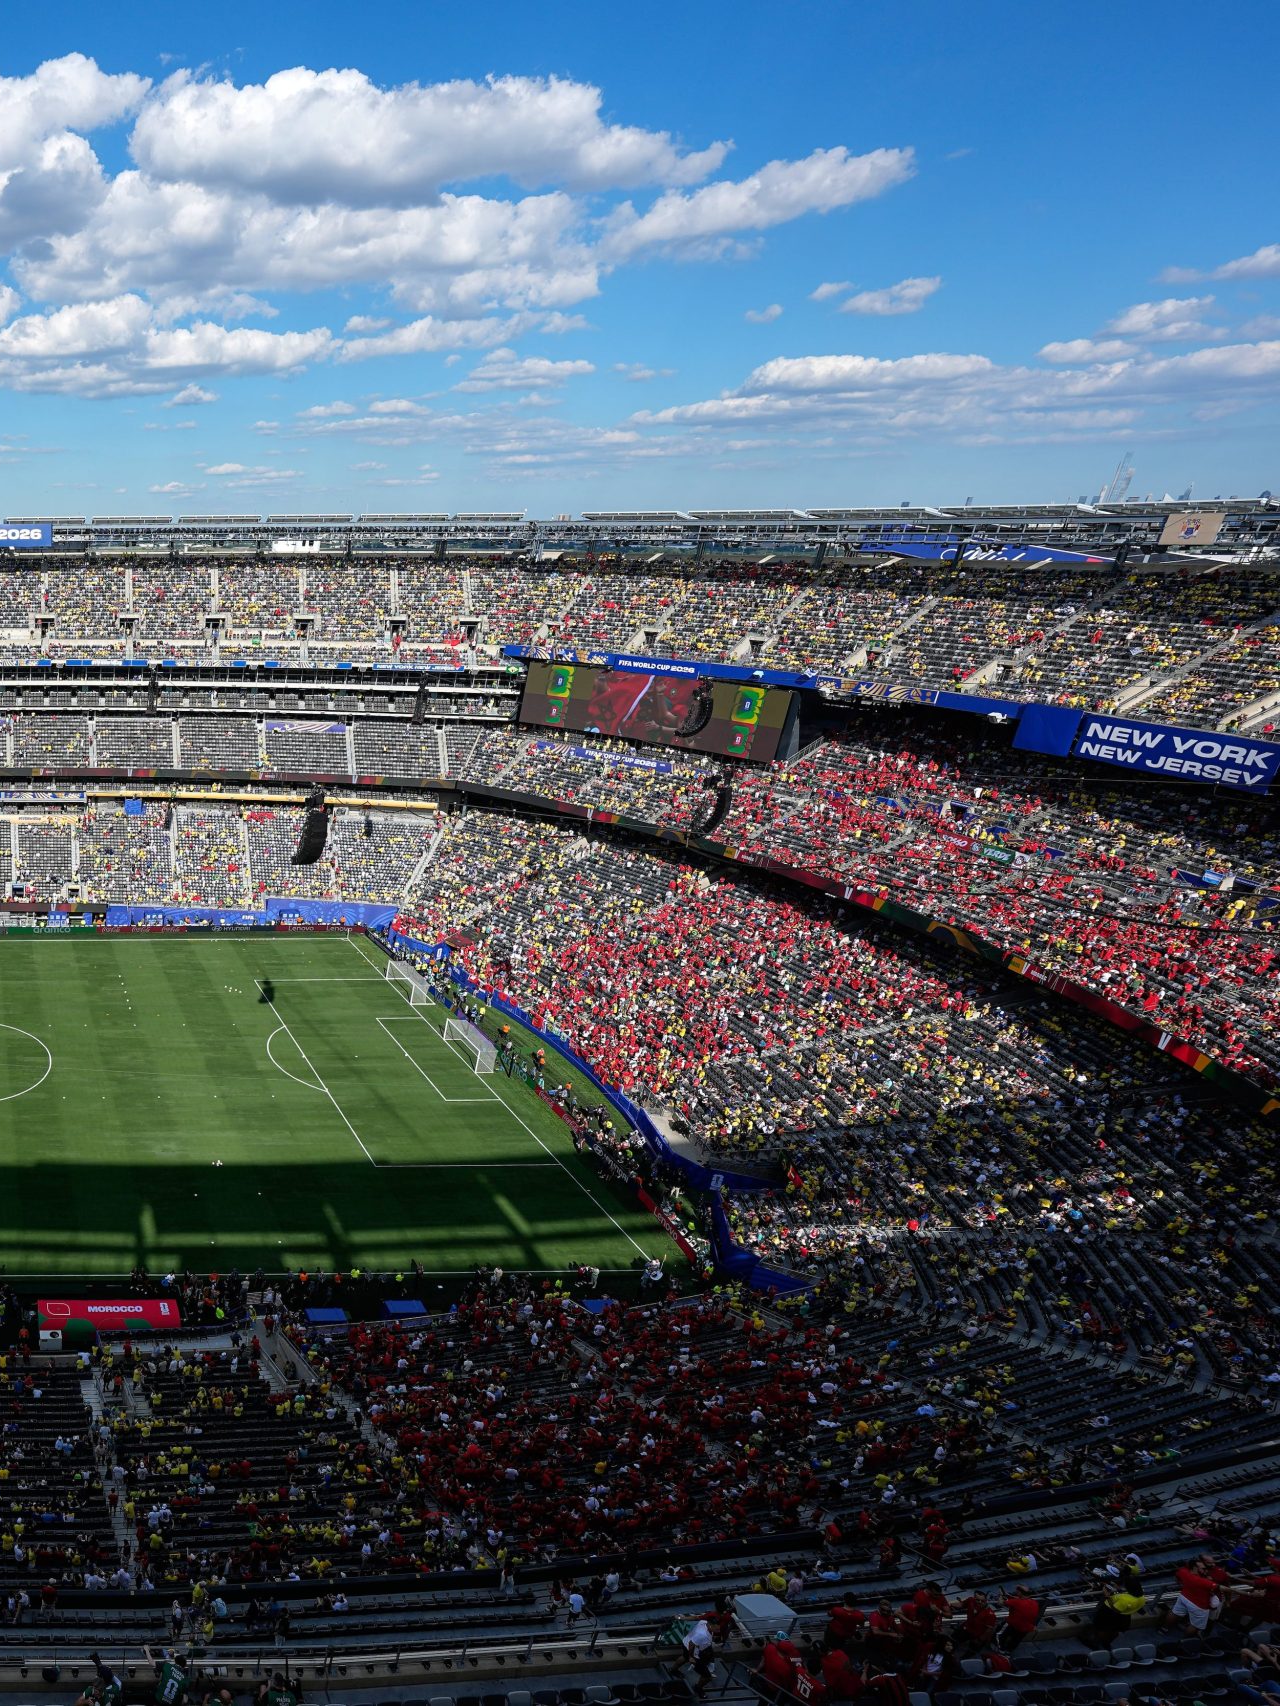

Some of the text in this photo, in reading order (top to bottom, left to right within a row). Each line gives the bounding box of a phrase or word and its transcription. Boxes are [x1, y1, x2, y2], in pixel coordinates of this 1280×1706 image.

[618, 659, 695, 674] FIFA WORLD CUP 2026
[1086, 722, 1275, 769] NEW YORK
[634, 759, 657, 768] 2026
[1079, 741, 1264, 786] NEW JERSEY
[653, 1207, 678, 1241] Lenovo
[87, 1305, 143, 1313] MOROCCO
[796, 1678, 811, 1699] 10
